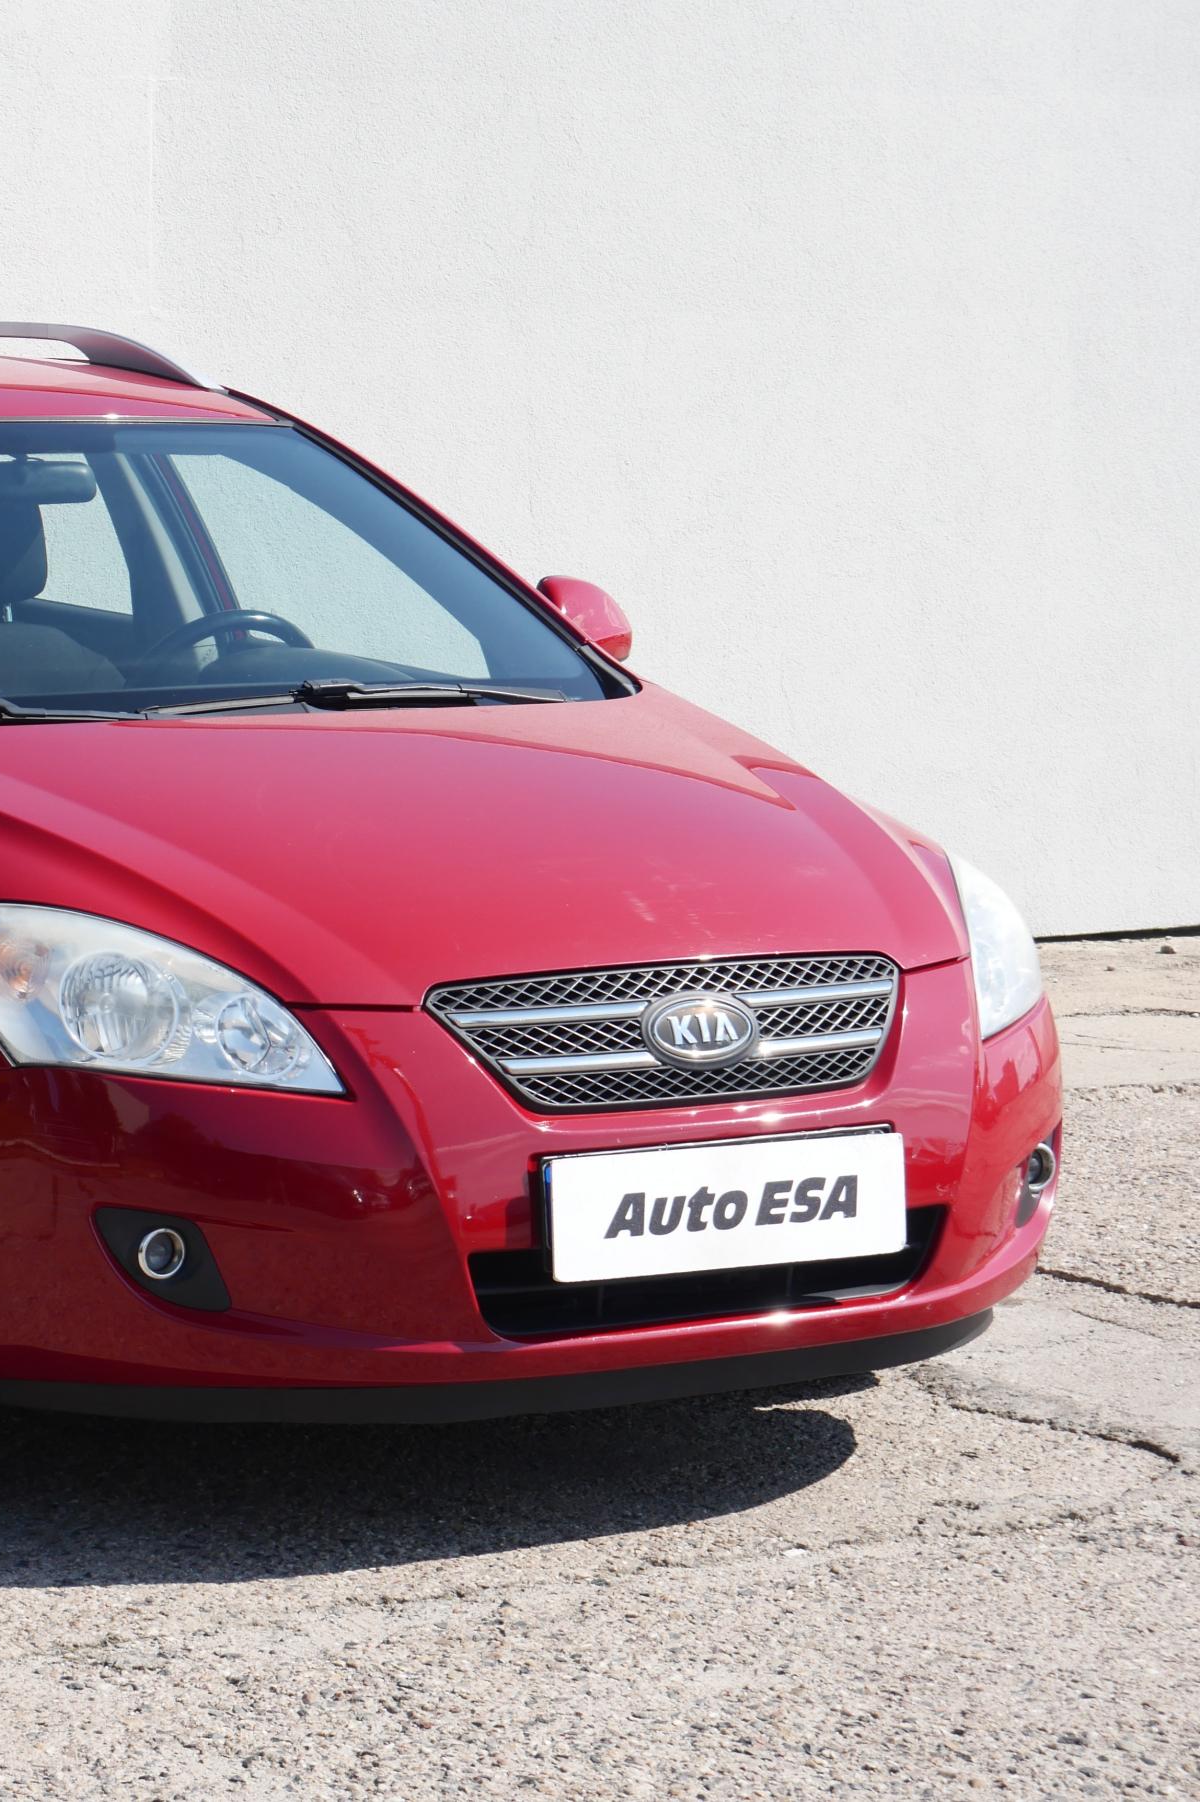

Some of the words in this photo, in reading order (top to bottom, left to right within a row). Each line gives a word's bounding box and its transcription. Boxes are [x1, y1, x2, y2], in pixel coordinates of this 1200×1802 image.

[666, 1011, 739, 1045] KIA
[603, 1185, 749, 1239] Auto
[754, 1174, 858, 1226] ESA
